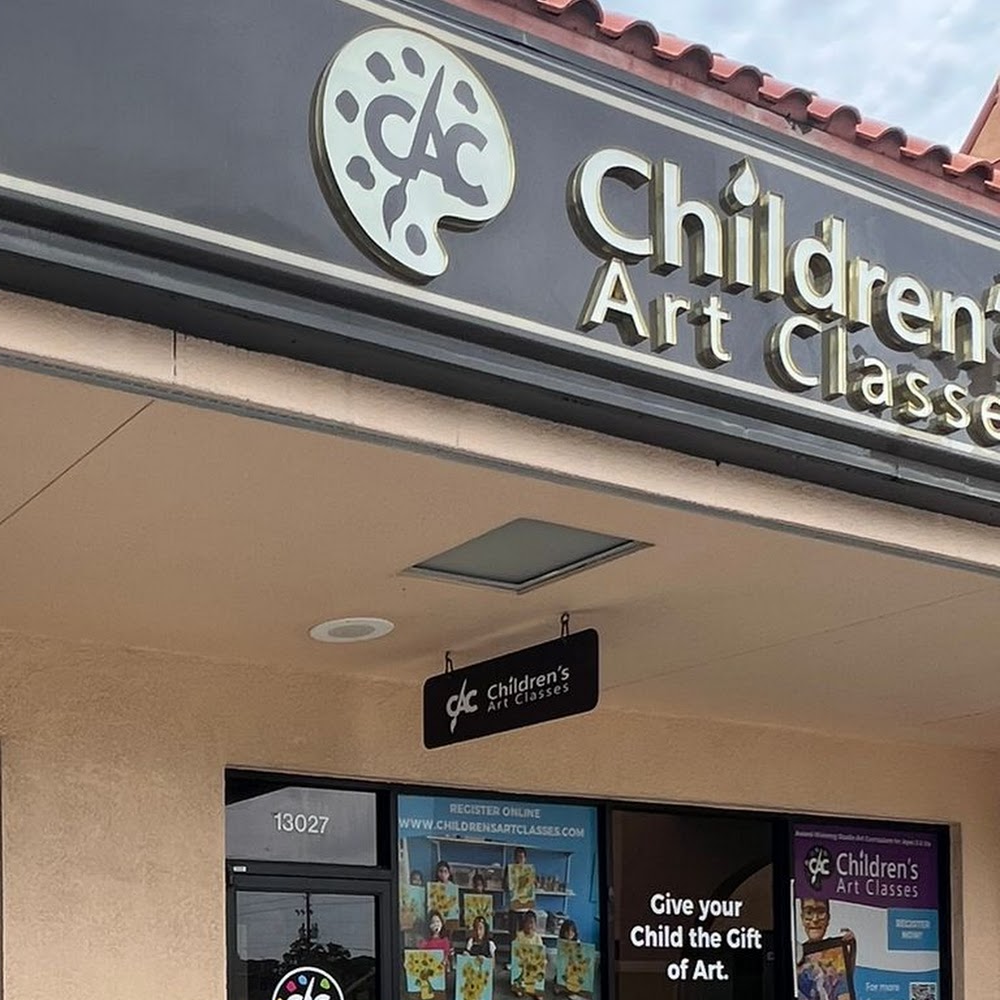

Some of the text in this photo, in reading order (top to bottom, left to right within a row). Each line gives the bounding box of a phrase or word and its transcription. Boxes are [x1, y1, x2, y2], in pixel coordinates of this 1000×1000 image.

[363, 66, 488, 210] CAC
[577, 258, 732, 368] Art
[487, 665, 570, 700] Children's
[487, 682, 570, 713] Art Classes
[274, 812, 329, 834] 13027
[450, 803, 541, 819] REGISTER ONLINE
[400, 818, 584, 837] WWW.CHILDRENSARTCLASSES.COM
[836, 850, 919, 880] Children's
[836, 878, 918, 897] Art Classes
[650, 892, 743, 921] Give your
[630, 925, 762, 949] Child the Gift
[667, 958, 729, 980] of Art.
